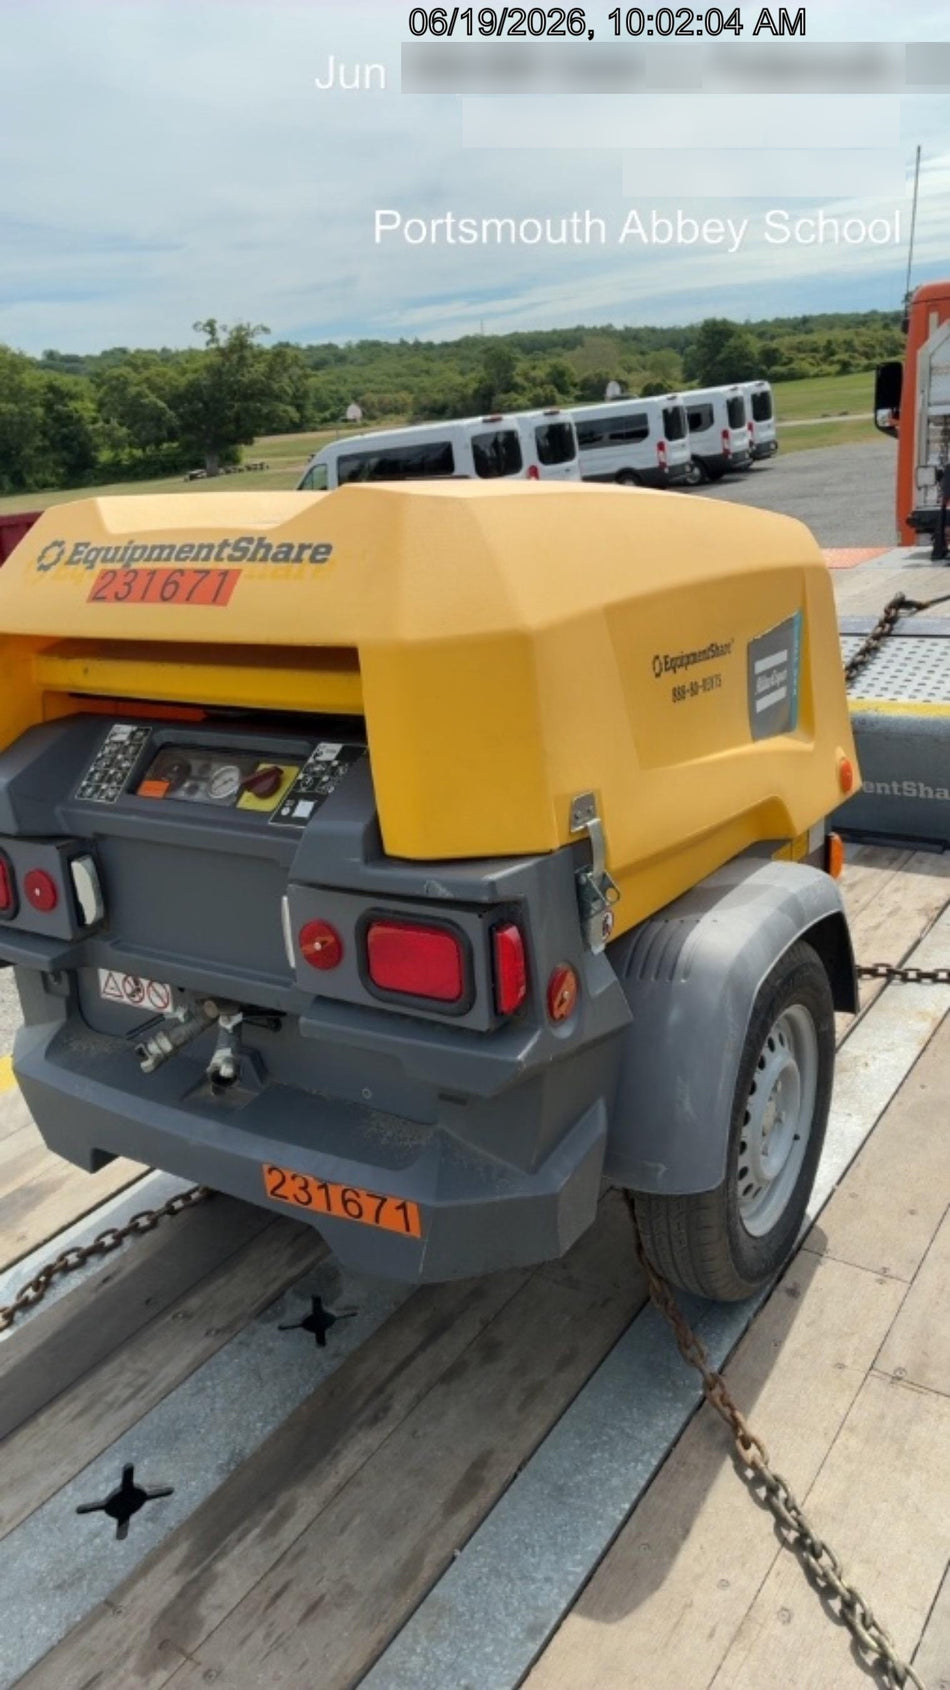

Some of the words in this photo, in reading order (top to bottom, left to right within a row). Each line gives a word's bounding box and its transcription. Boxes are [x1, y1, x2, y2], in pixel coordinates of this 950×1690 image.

[64, 536, 333, 569] EquipmentShare
[91, 569, 231, 604] 231671
[663, 642, 732, 674] EquipmentShare
[268, 1167, 411, 1233] 231671
